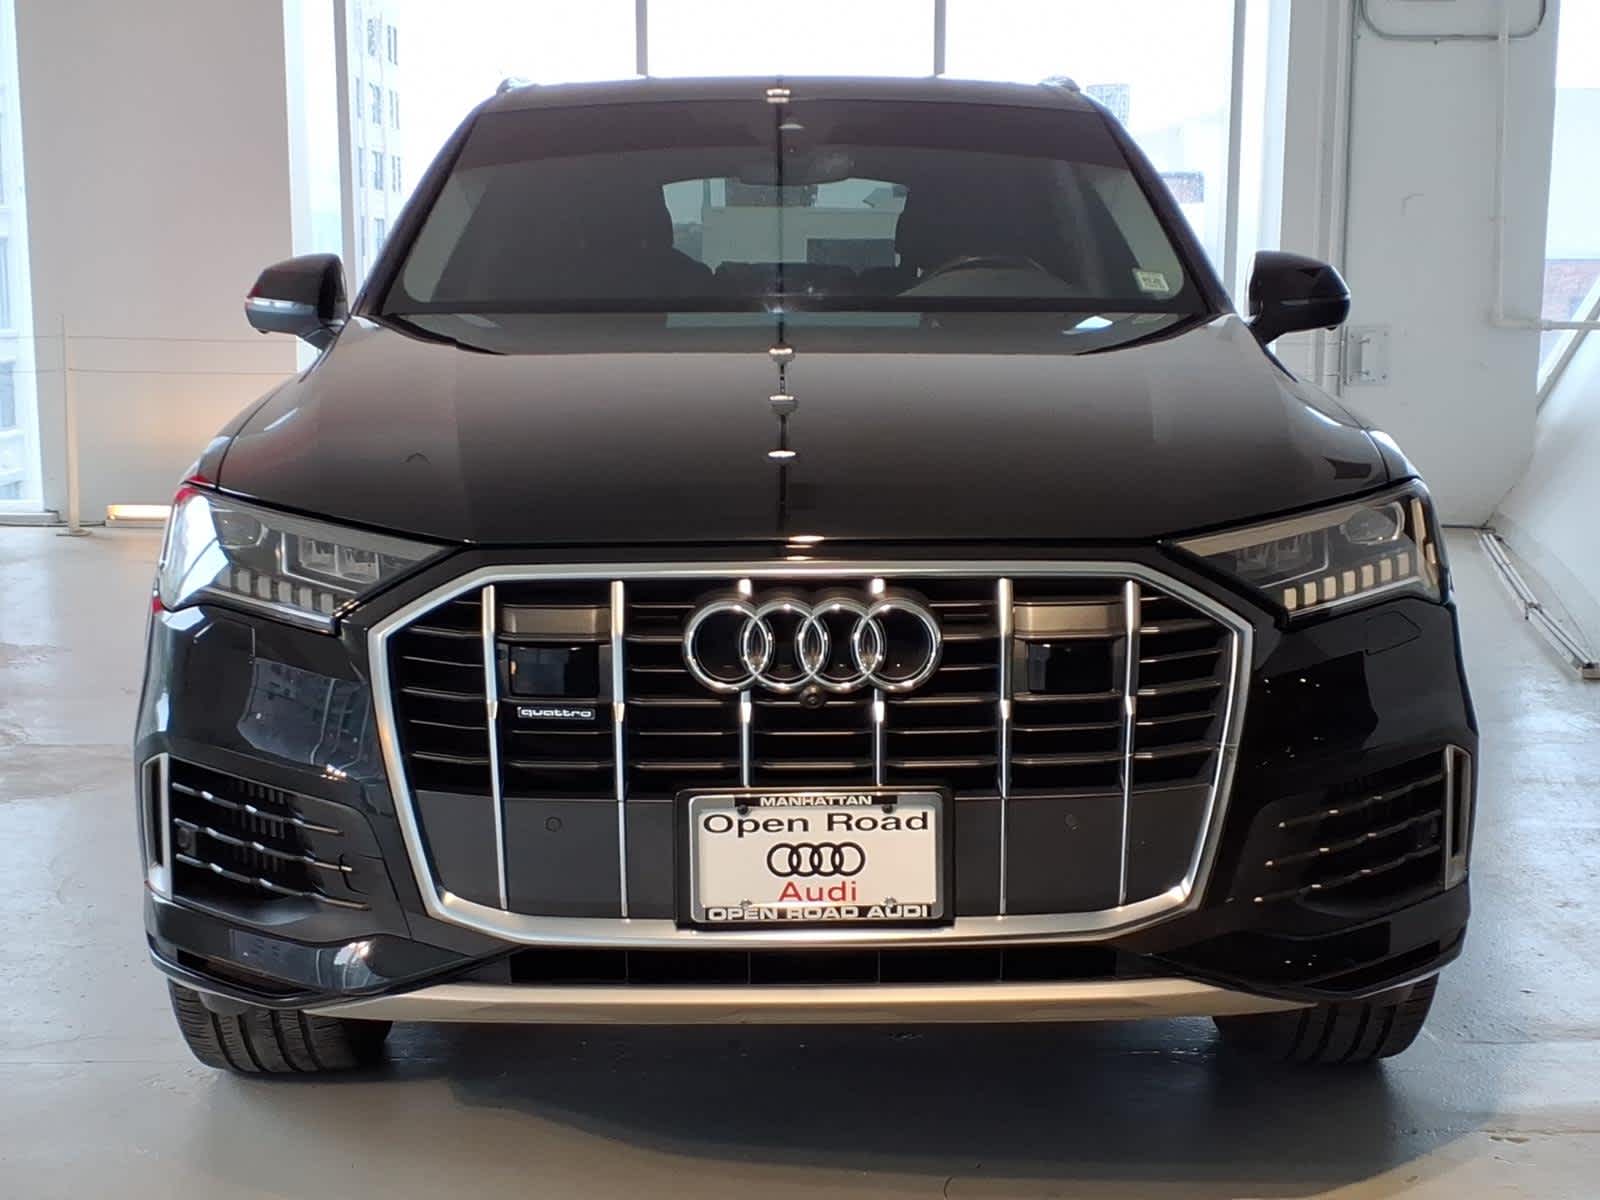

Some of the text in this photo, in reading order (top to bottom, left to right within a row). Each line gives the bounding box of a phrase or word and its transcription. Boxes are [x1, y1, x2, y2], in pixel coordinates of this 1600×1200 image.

[521, 709, 592, 718] quattro
[760, 795, 873, 808] MANHATTAN
[703, 812, 929, 838] Open Road
[778, 880, 857, 902] Audi
[708, 904, 928, 920] OPEN ROAD AUDI
